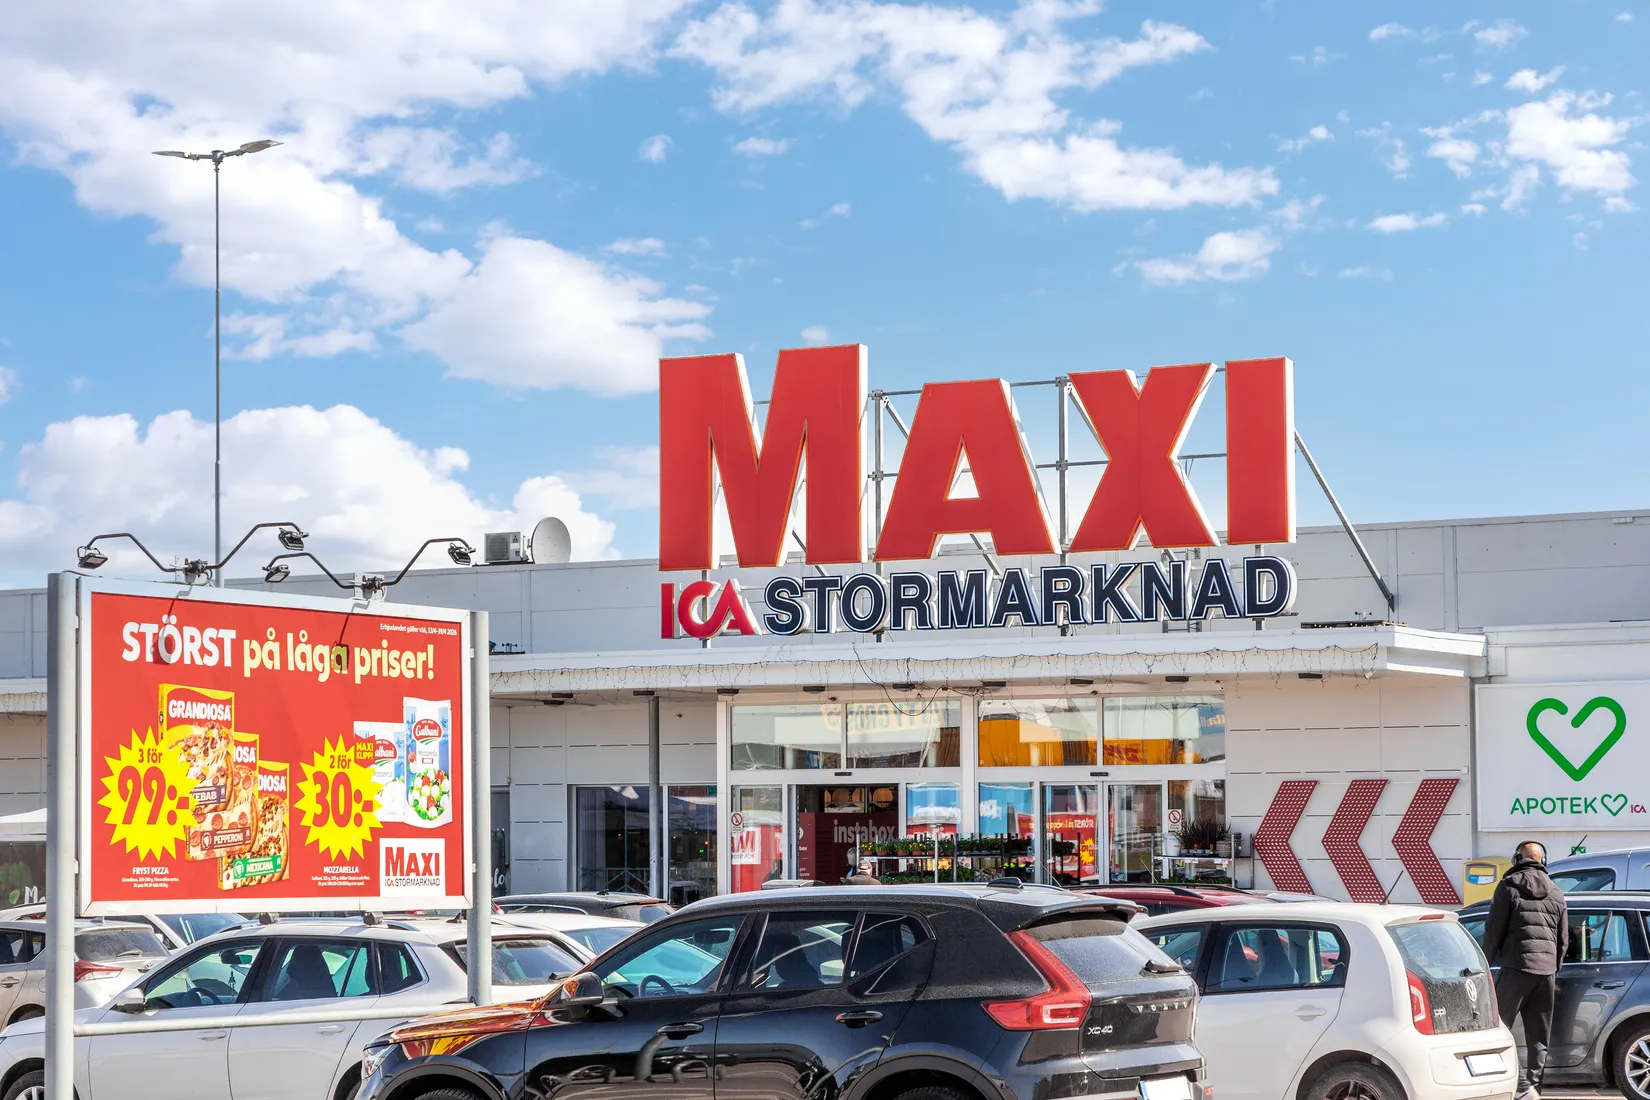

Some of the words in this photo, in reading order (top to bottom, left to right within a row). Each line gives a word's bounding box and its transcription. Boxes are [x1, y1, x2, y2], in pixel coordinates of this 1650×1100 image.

[659, 344, 1294, 571] MAXI
[661, 578, 758, 639] ICA
[763, 556, 1297, 636] STORMARKNAD
[121, 614, 236, 667] STÖRST
[243, 627, 281, 677] på
[287, 629, 348, 682] låga
[354, 638, 435, 684] priser!
[168, 699, 231, 721] GRANDIOSA
[415, 725, 439, 737] Galbani
[356, 742, 374, 751] MAXI
[138, 748, 144, 763] 3
[147, 748, 162, 763] för
[329, 755, 335, 769] 2
[337, 755, 351, 769] för
[118, 766, 189, 825] 99:-
[312, 771, 373, 827] 30:-
[1510, 797, 1598, 815] APOTEK
[1630, 804, 1647, 814] ICA
[213, 832, 243, 844] PEPPERONI
[833, 819, 896, 843] instabox
[246, 861, 273, 873] MEXICANA
[385, 847, 440, 876] MAXI
[323, 866, 359, 874] MOZZARELLA
[385, 878, 394, 887] ICA
[395, 878, 440, 887] STORMARKNAD
[1136, 1001, 1188, 1013] VOLVO
[1087, 1024, 1113, 1035] XC40
